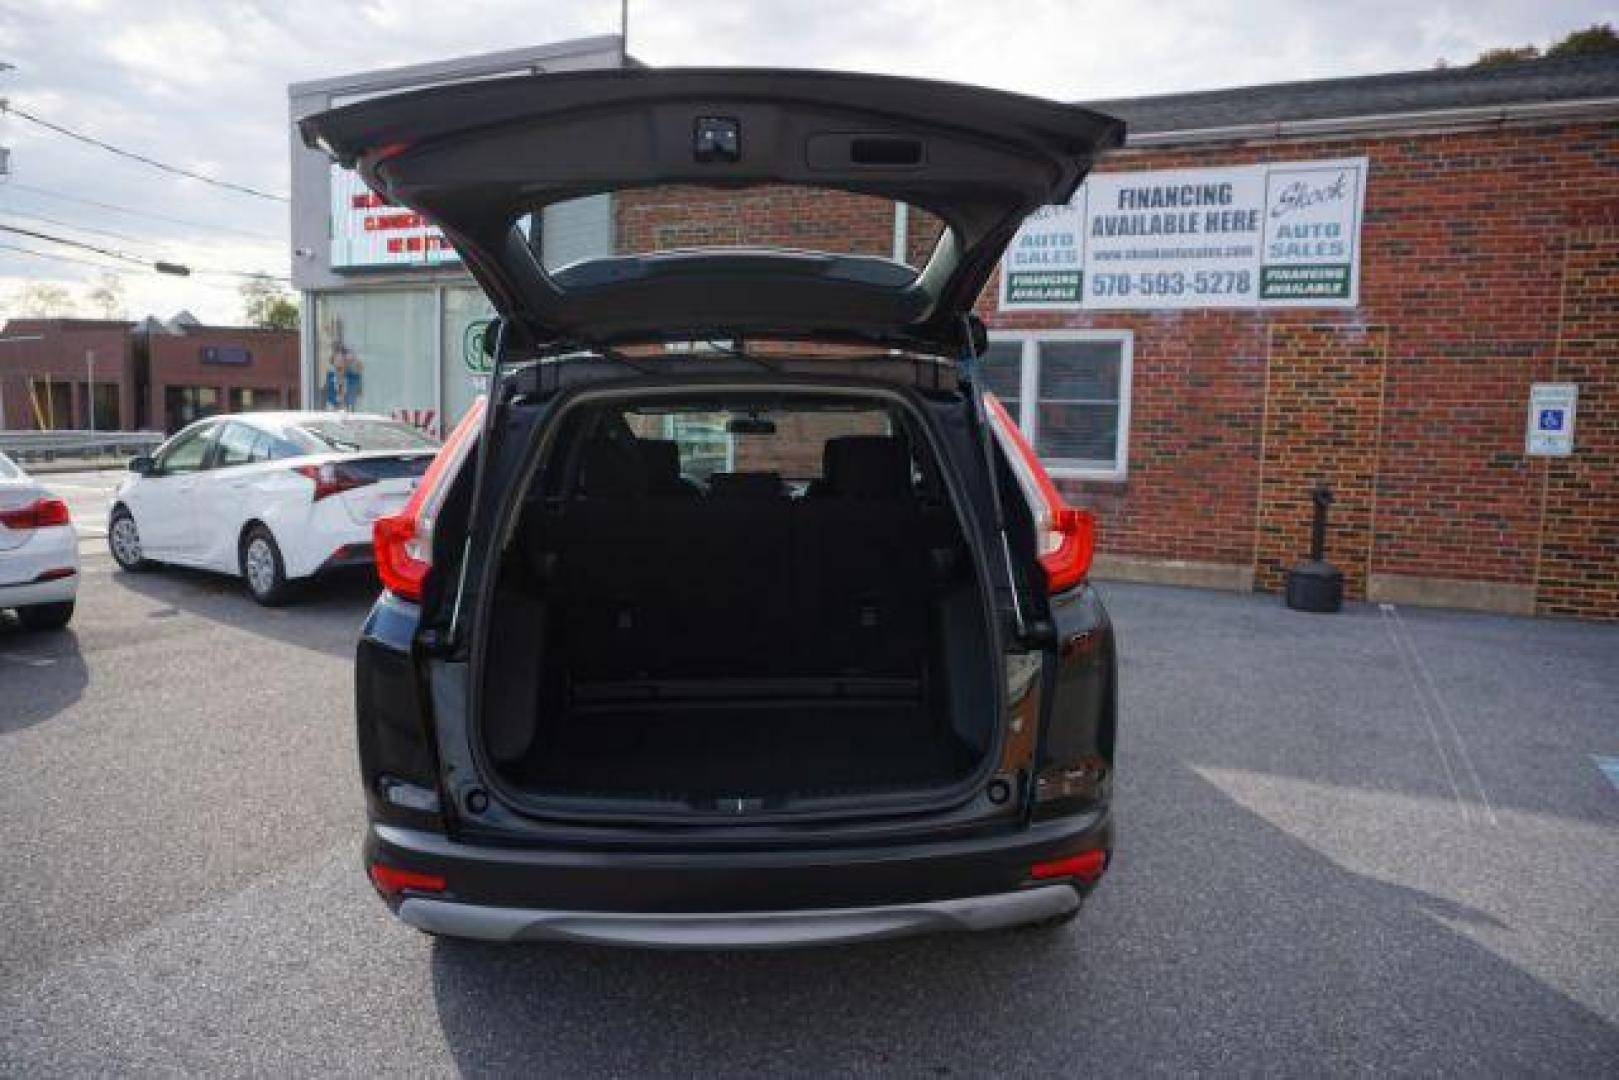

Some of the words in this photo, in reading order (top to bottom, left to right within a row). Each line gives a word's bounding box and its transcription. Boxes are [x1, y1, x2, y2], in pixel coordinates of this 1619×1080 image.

[1118, 182, 1232, 210] FINANCING
[1092, 212, 1200, 237] AVAILABLE
[1204, 210, 1258, 233] HERE
[1277, 223, 1341, 239] AUTO
[1019, 233, 1074, 248] AUTO
[1271, 241, 1343, 256] SALES
[1015, 250, 1077, 264] SALES
[1092, 270, 1251, 297] 570-593-5278
